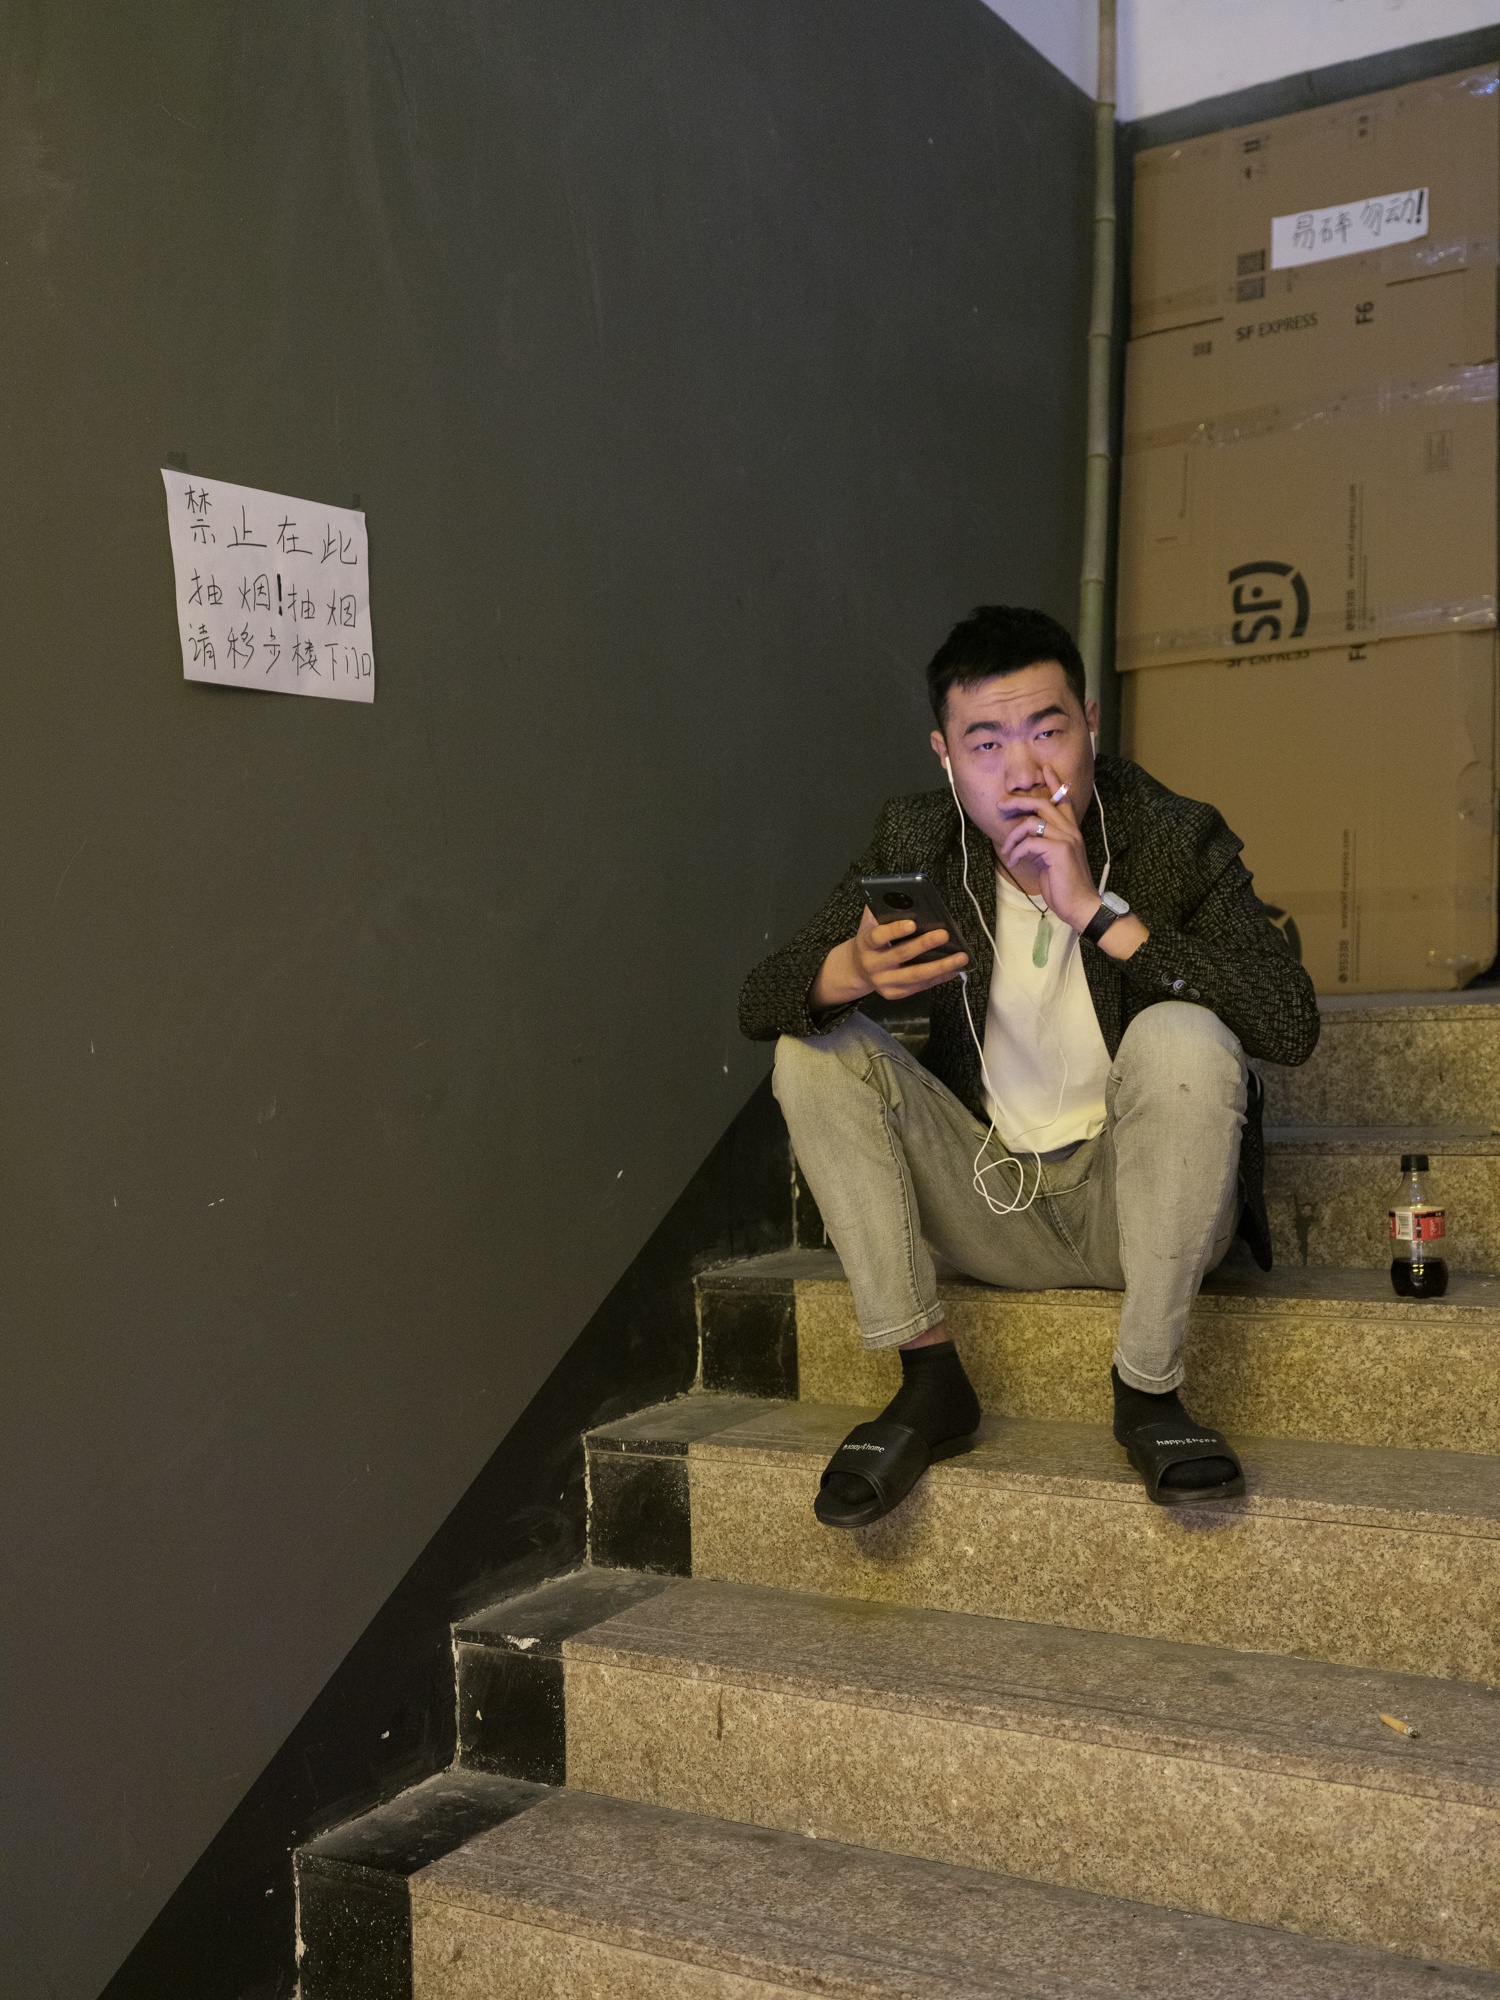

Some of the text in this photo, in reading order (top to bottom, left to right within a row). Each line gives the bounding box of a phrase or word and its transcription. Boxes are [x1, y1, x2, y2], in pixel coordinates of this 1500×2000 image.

[1236, 325, 1255, 341] SF
[184, 484, 358, 565] 禁止在此
[187, 568, 358, 628] 抽烟!抽烟
[188, 622, 373, 682] 请移步楼下门口
